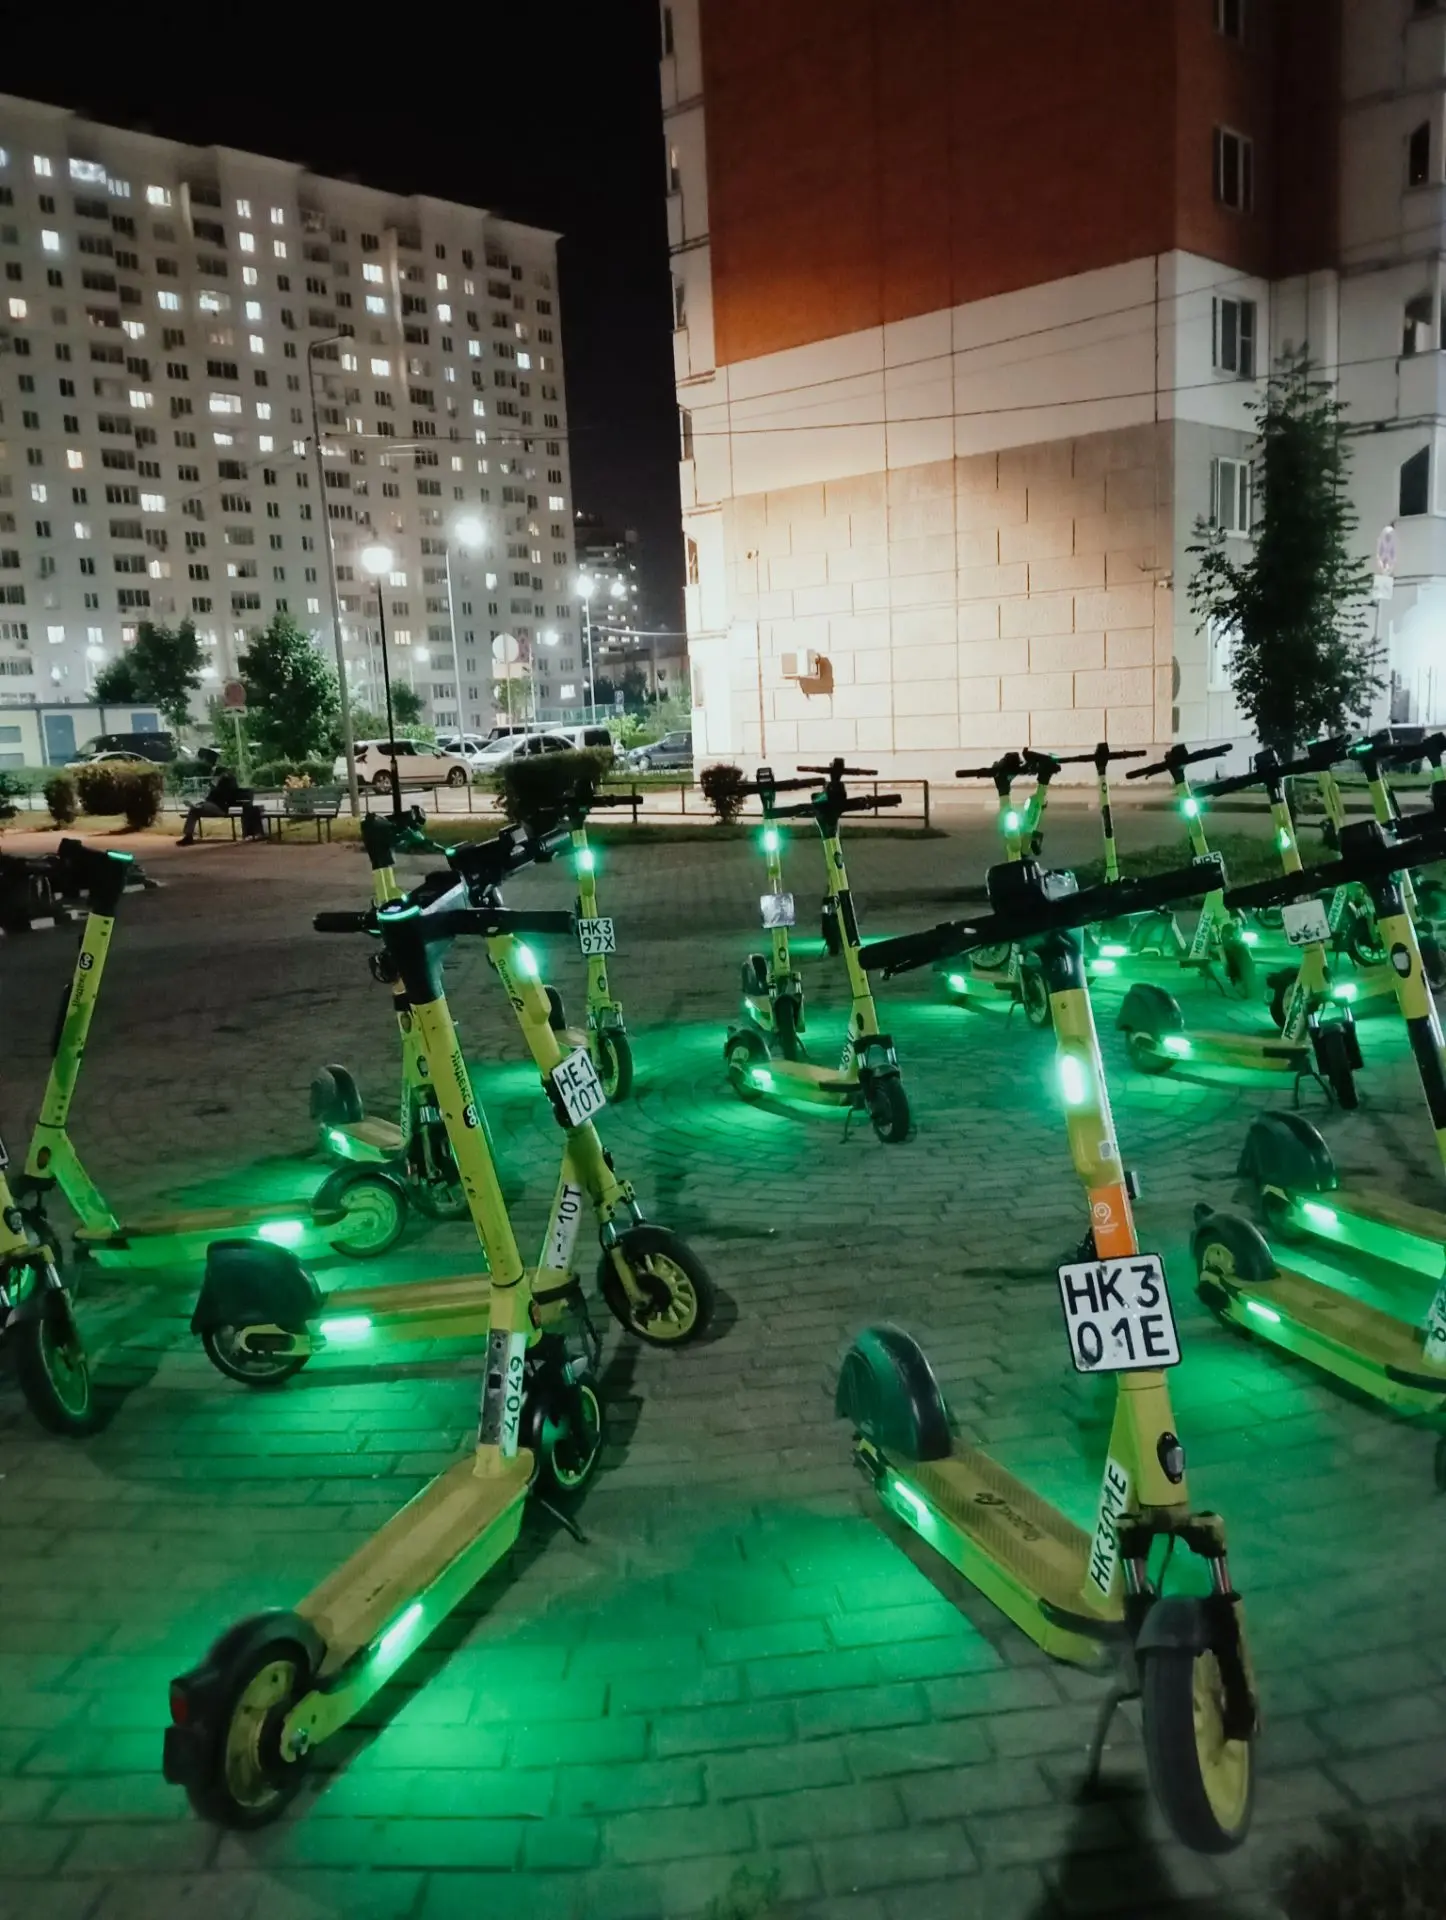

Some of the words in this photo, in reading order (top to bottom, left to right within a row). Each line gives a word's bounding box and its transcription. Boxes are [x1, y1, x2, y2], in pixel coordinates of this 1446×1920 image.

[580, 919, 612, 936] HK3
[582, 936, 615, 952] 97X
[450, 1050, 471, 1103] Яндекс
[556, 1055, 594, 1097] HE1
[570, 1078, 601, 1118] 10T
[1064, 1263, 1160, 1315] HK3
[1077, 1313, 1170, 1364] 01E
